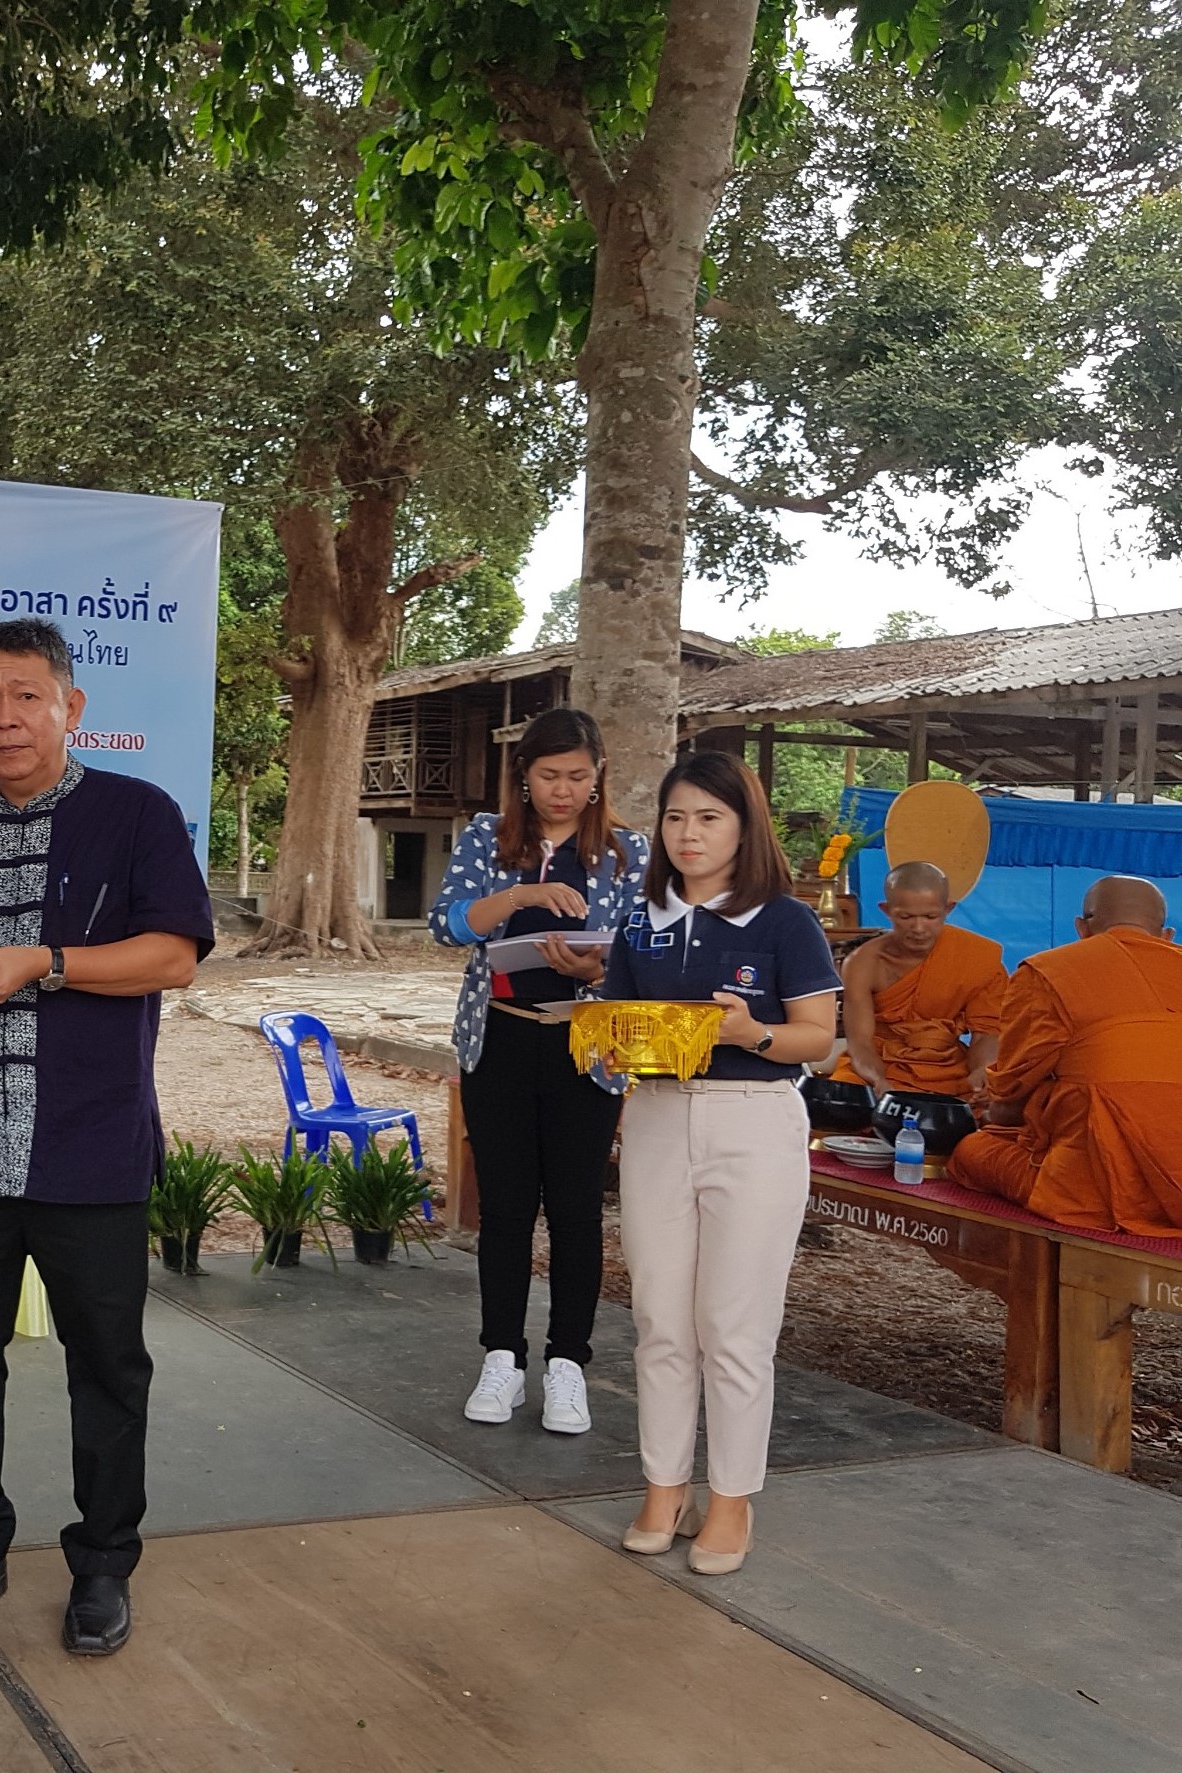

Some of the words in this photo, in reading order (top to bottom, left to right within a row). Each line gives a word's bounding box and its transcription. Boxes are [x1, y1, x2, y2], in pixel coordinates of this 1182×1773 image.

[77, 577, 150, 622] ครั้งที่
[158, 601, 178, 623] ๙
[875, 1209, 949, 1247] พ.ศ.2560
